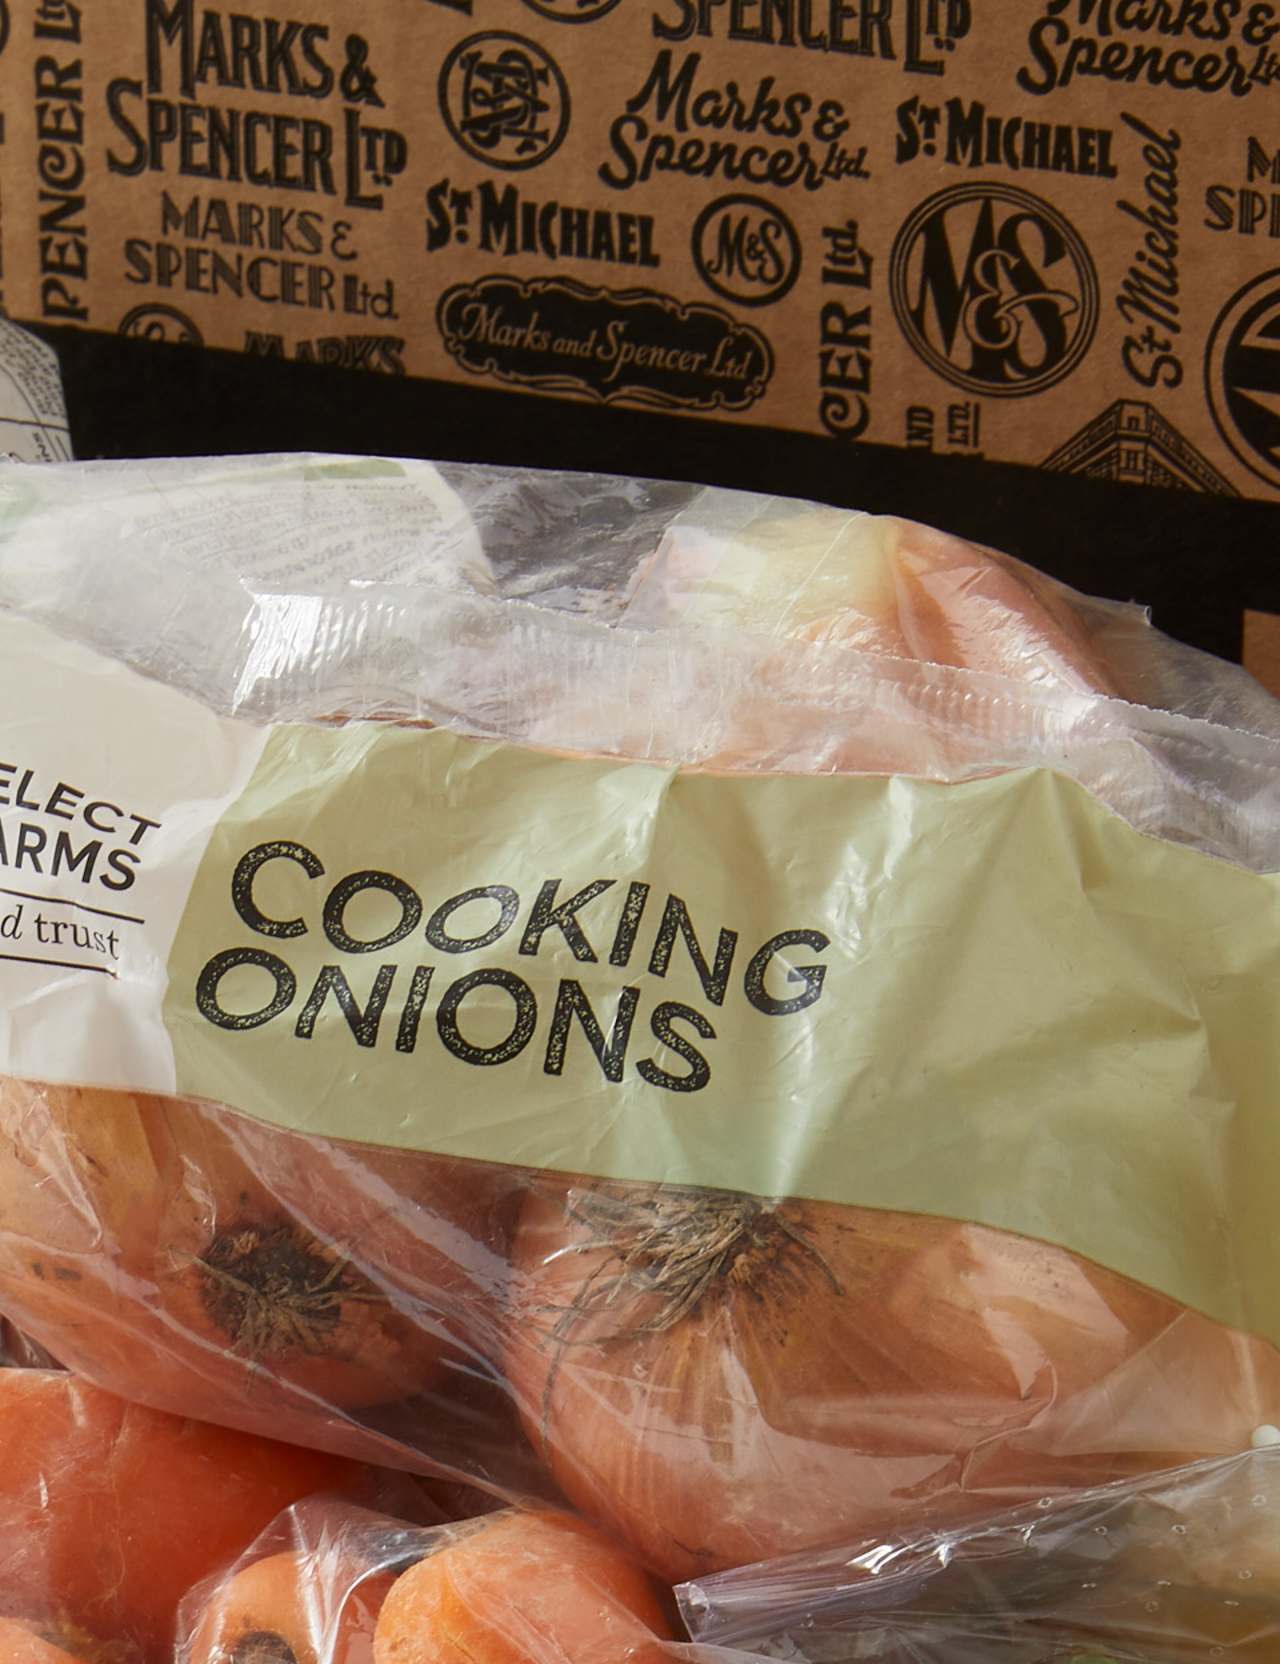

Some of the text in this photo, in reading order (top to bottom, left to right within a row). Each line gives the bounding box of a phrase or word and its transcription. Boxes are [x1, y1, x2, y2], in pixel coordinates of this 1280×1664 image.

[144, 0, 336, 99] MARKS
[339, 33, 385, 108] &
[626, 49, 812, 138] Marks
[813, 99, 850, 142] &
[1016, 16, 1253, 97] Spencer
[106, 77, 337, 196] SPENCER
[597, 114, 824, 191] Spencer
[944, 97, 1118, 179] MICHAEL
[161, 190, 324, 257] MARKS
[477, 180, 660, 268] MICHAEL
[1116, 112, 1183, 335] Michael
[125, 238, 335, 313] SPENCER
[458, 302, 551, 351] Marks
[552, 330, 597, 359] and
[596, 321, 707, 383] Spencer
[34, 912, 120, 960] trust
[231, 840, 832, 1016] COOKING
[195, 946, 718, 1092] ONIONS
